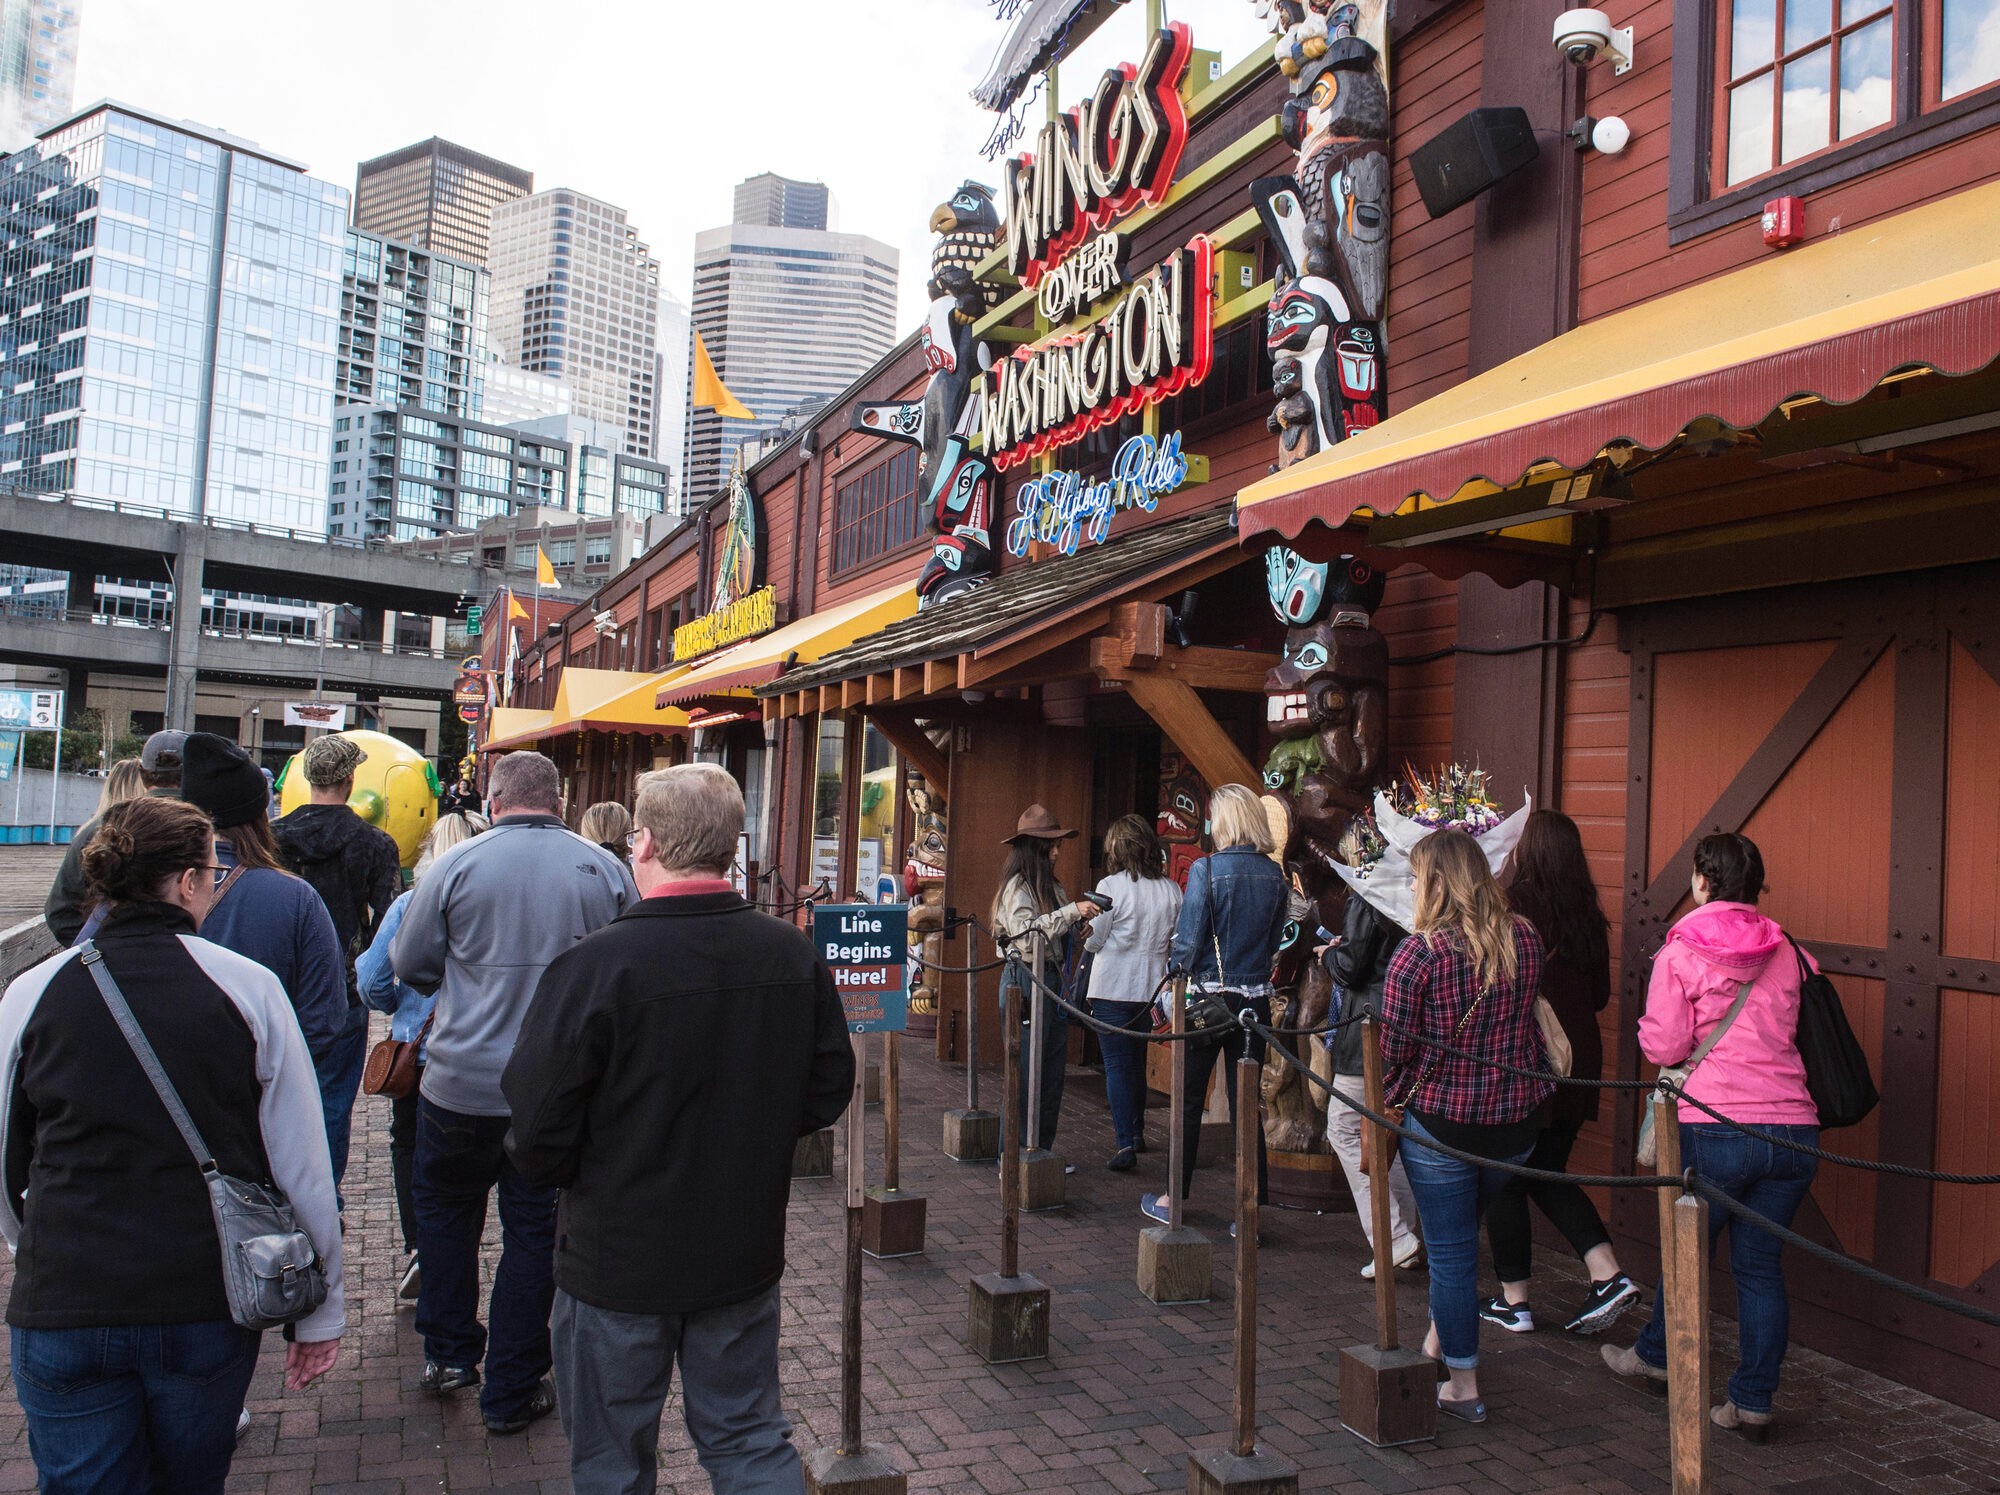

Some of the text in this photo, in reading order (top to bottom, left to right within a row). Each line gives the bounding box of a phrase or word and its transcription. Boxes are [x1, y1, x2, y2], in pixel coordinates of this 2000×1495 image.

[1005, 29, 1172, 276] WINGS
[1038, 232, 1125, 323] OVER
[980, 247, 1194, 457] WASHINGTON
[1038, 470, 1114, 556] Flying
[1111, 430, 1188, 513] Ride
[826, 941, 892, 964] Begins
[840, 915, 882, 934] Line
[835, 967, 887, 986] Here!
[843, 994, 879, 1007] WINGS
